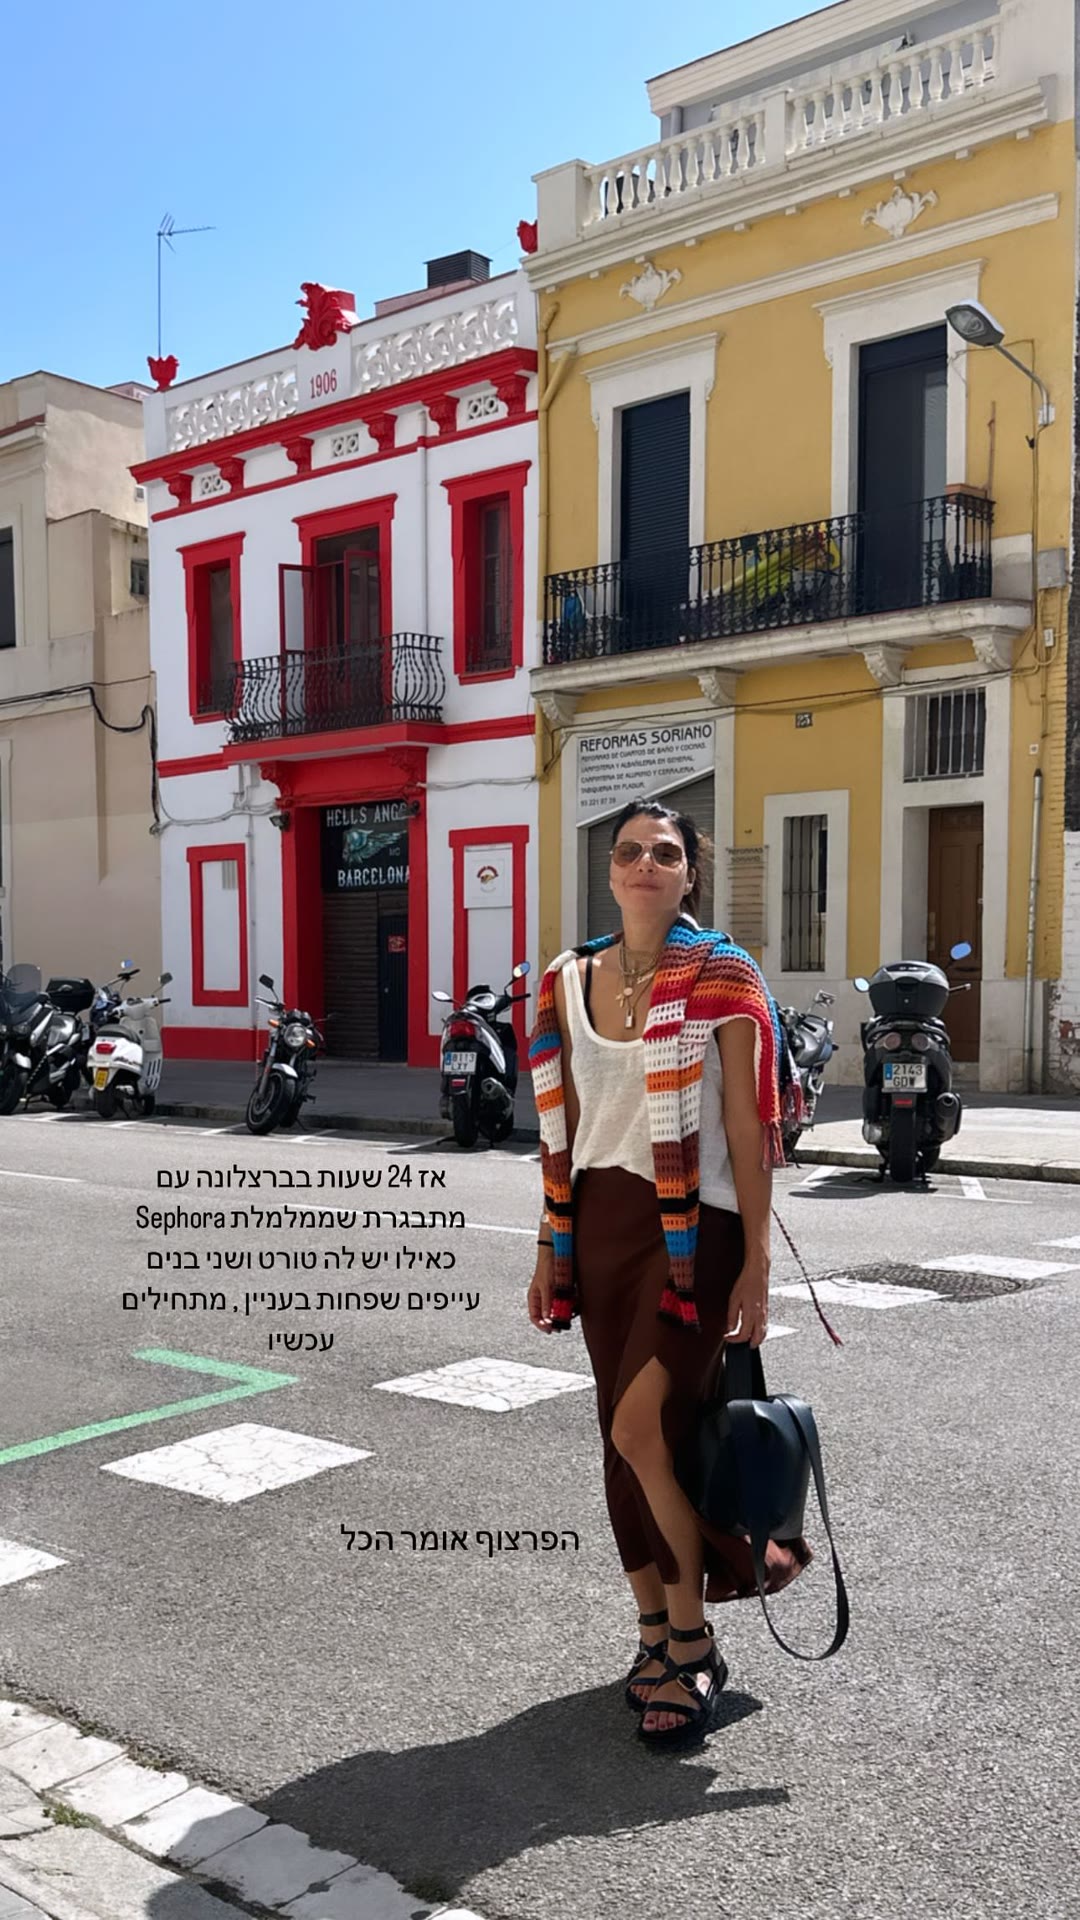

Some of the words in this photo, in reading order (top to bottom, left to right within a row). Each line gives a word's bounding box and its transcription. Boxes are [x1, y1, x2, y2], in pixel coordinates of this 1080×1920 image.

[310, 368, 337, 399] 1906
[580, 732, 647, 752] REFORMAS
[651, 724, 712, 744] SORIANO
[611, 751, 619, 760] DE
[619, 748, 646, 759] CUARTOS
[647, 747, 656, 756] DE
[326, 806, 367, 827] HELLS
[338, 865, 409, 887] BARCELONA
[893, 1063, 924, 1076] 2143
